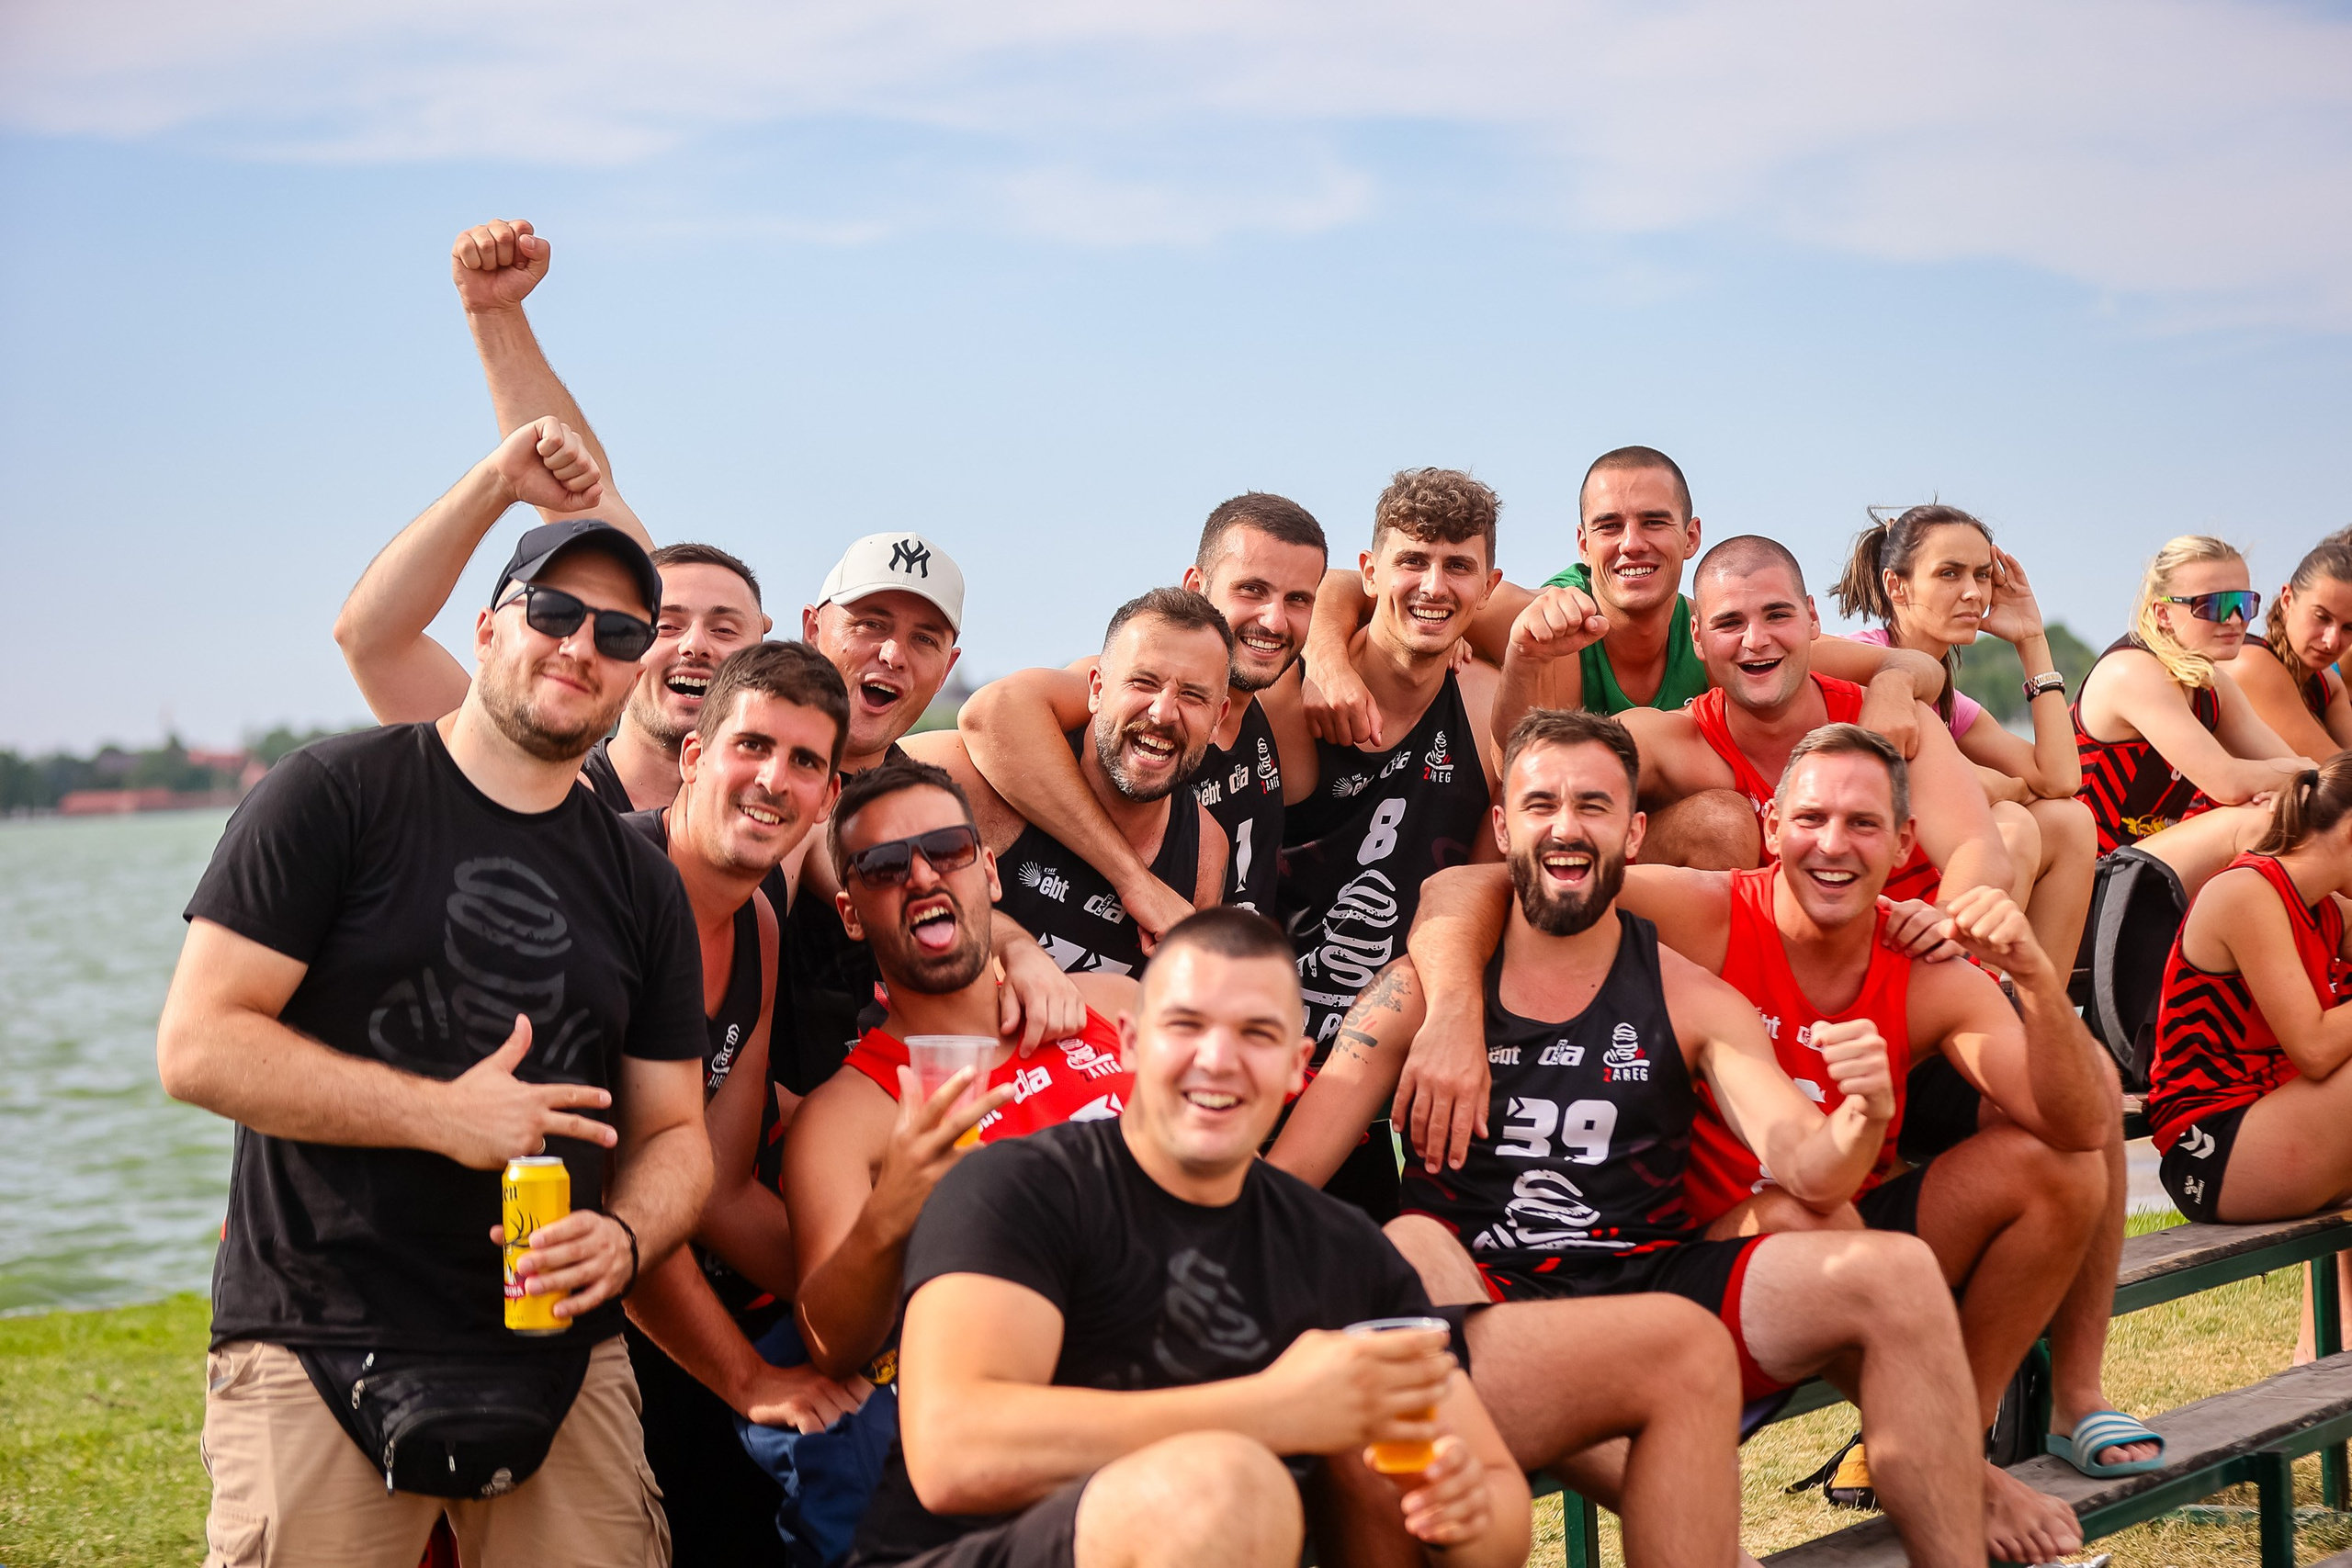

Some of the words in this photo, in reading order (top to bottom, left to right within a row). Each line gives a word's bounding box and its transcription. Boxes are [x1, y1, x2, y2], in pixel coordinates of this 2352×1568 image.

[888, 538, 932, 579] NY
[1201, 781, 1222, 807] ebt
[1356, 797, 1407, 866] 8
[1039, 875, 1070, 903] ebt
[1495, 1096, 1619, 1166] 39
